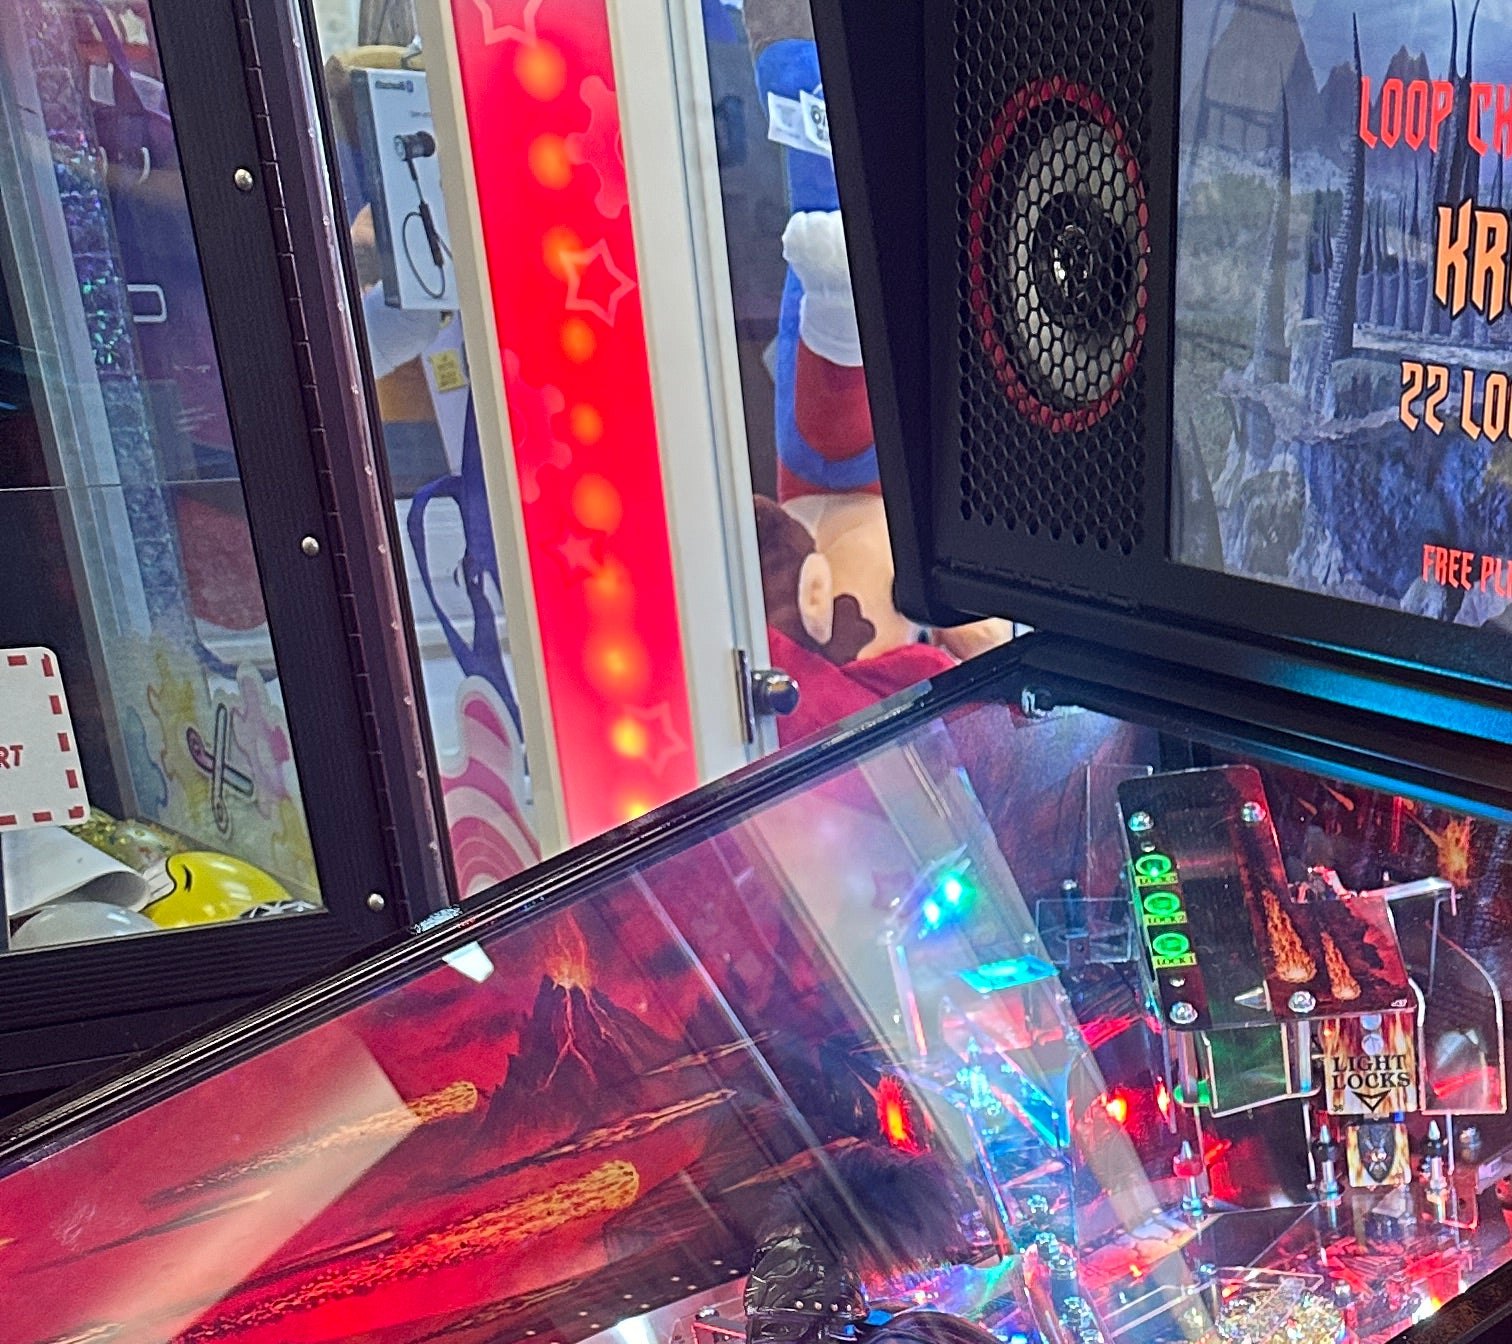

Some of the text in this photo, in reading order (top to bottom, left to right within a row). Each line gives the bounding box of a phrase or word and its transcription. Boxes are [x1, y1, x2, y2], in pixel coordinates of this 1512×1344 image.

[1359, 76, 1454, 153] LOOP
[1400, 361, 1449, 436] 22
[1422, 544, 1474, 590] FREE
[1332, 1072, 1411, 1090] LOCKS
[1333, 1054, 1406, 1072] LIGHT
